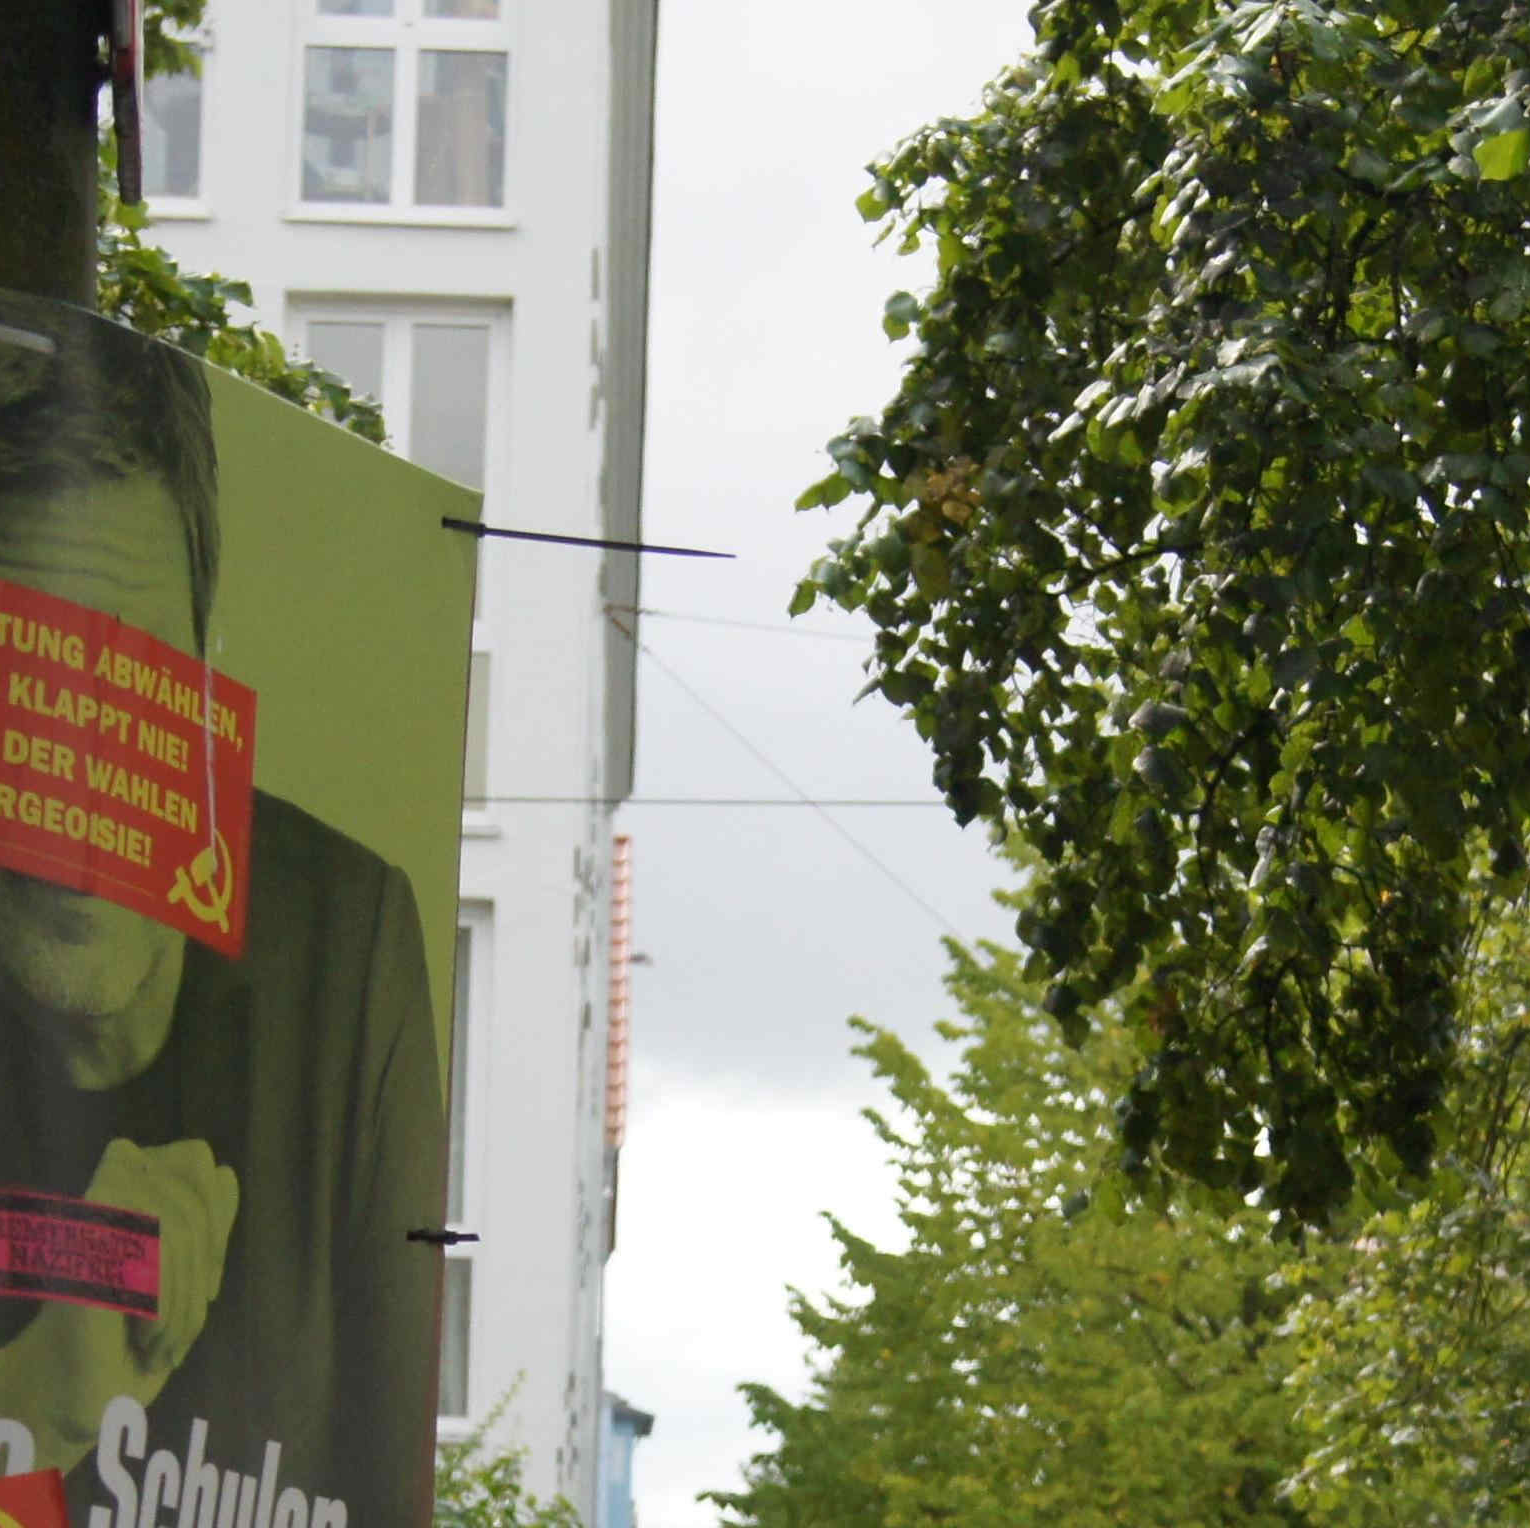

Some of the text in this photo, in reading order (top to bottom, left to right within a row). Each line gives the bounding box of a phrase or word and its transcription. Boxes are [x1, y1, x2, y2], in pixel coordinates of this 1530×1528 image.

[8, 672, 132, 747] KLAPPT
[138, 723, 189, 772] NIE!
[95, 646, 244, 753] ABWÄHLEN,
[3, 729, 75, 782] DER
[86, 751, 198, 835] WAHLEN
